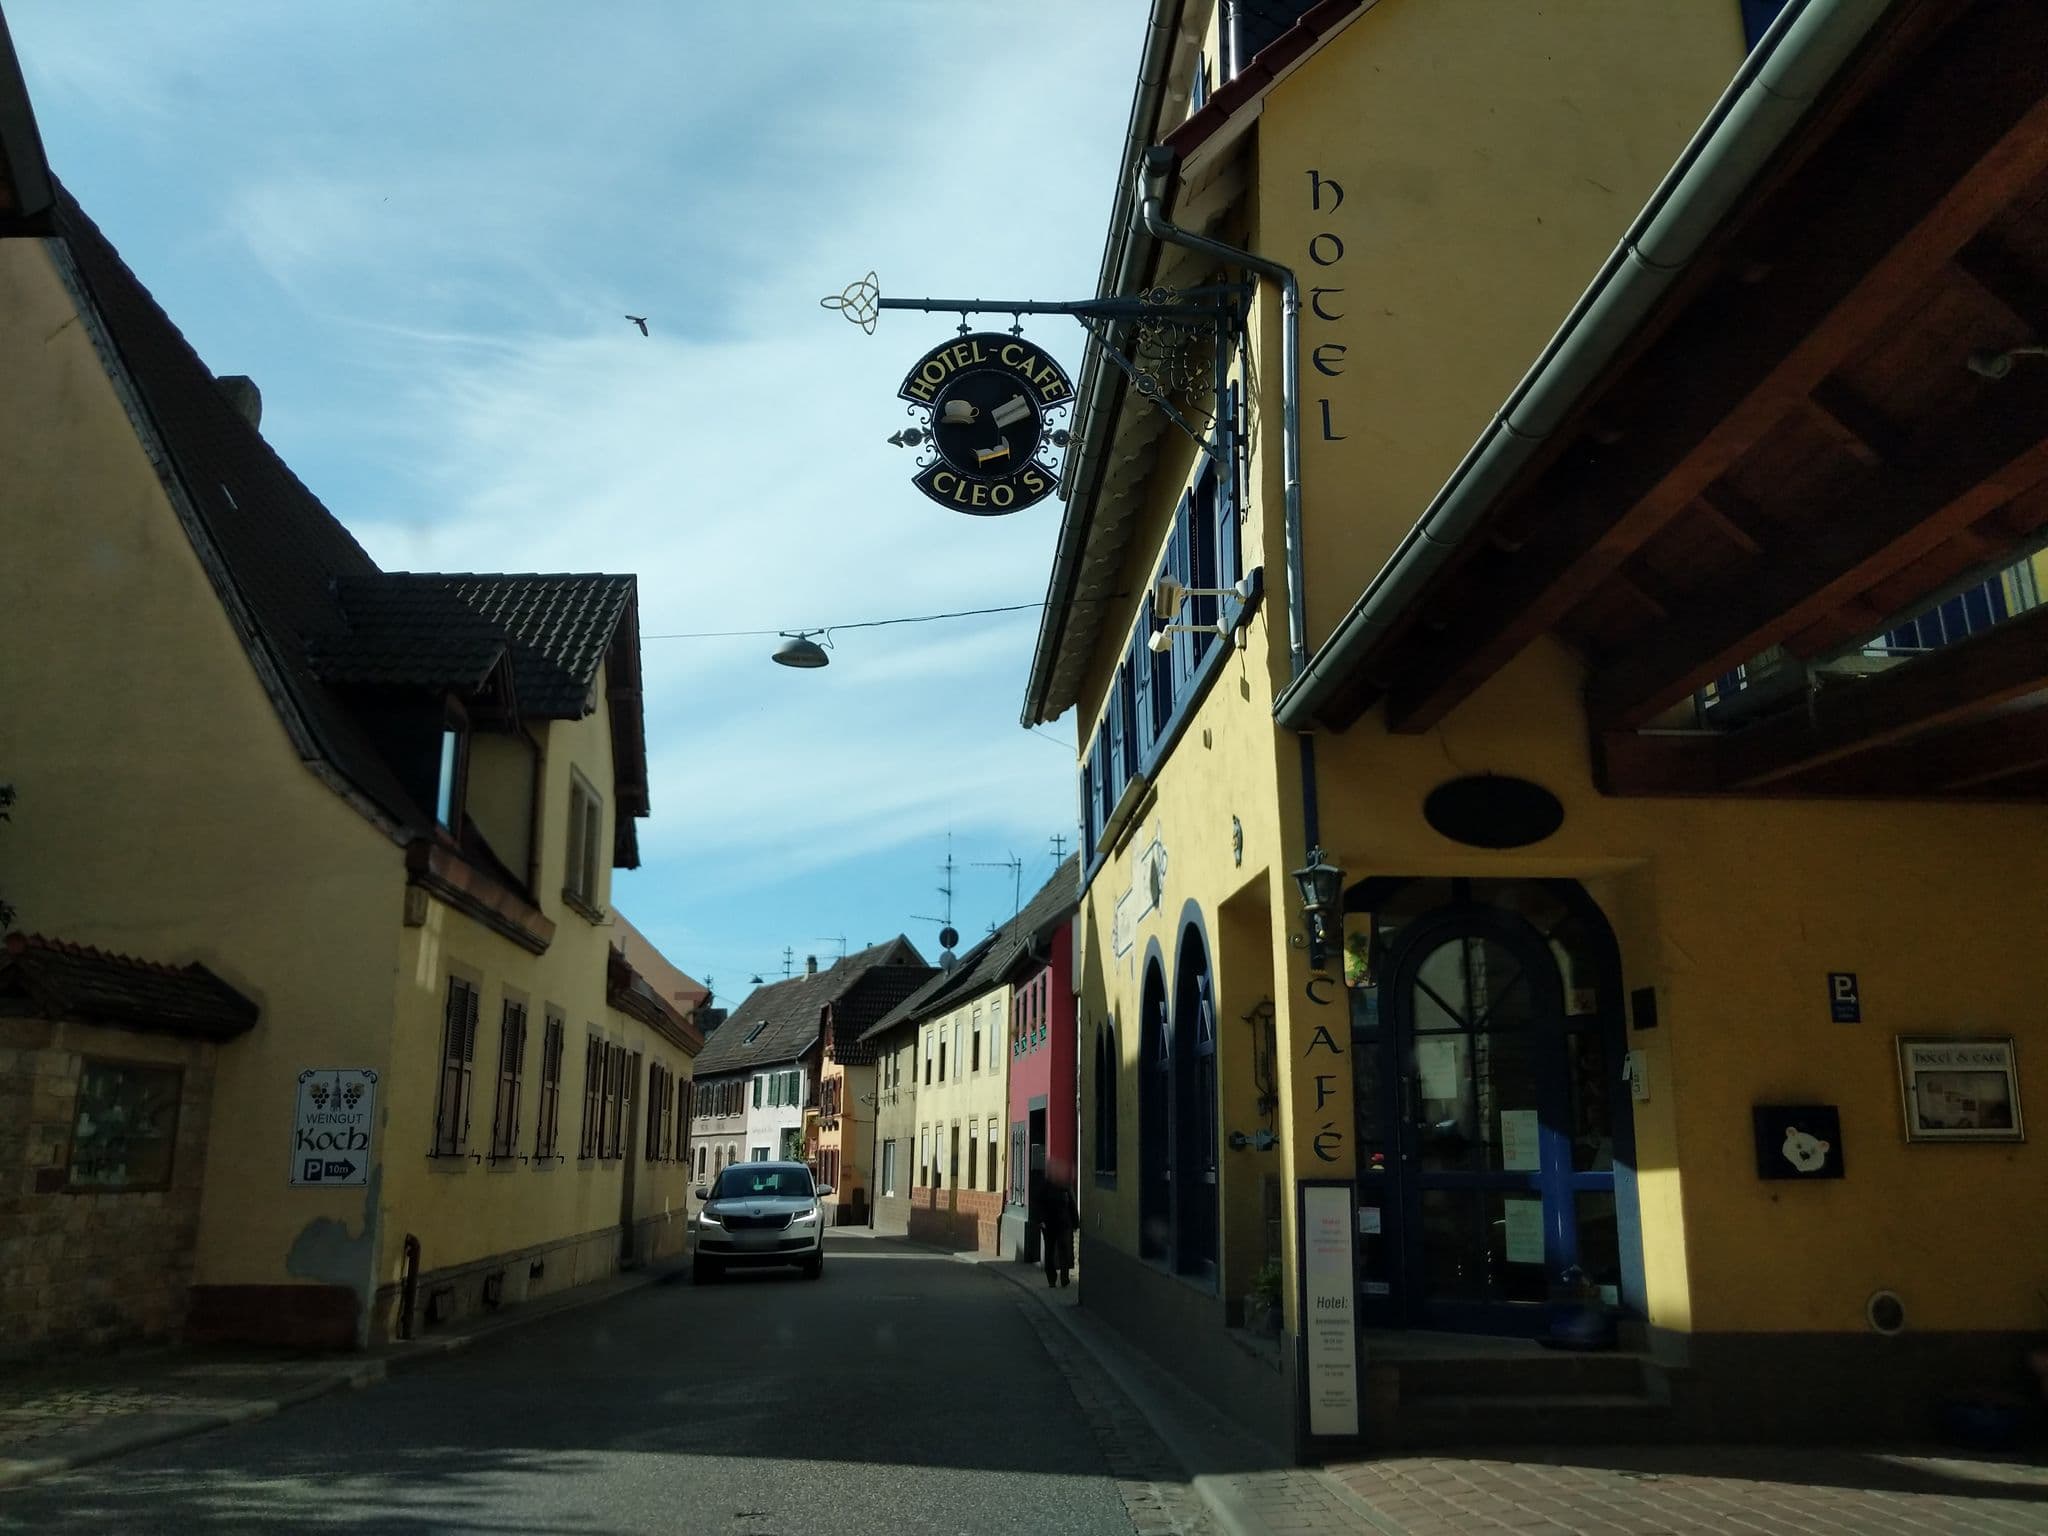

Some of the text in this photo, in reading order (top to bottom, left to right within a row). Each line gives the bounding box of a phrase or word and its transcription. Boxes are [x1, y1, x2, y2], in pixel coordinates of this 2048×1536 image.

[933, 471, 1045, 507] CLEO'S
[1304, 977, 1345, 1162] CAFÉ
[306, 1113, 364, 1124] WEINGUT
[297, 1126, 368, 1151] Koch
[306, 1161, 349, 1180] P 10m
[1316, 1295, 1349, 1310] Hotel:
